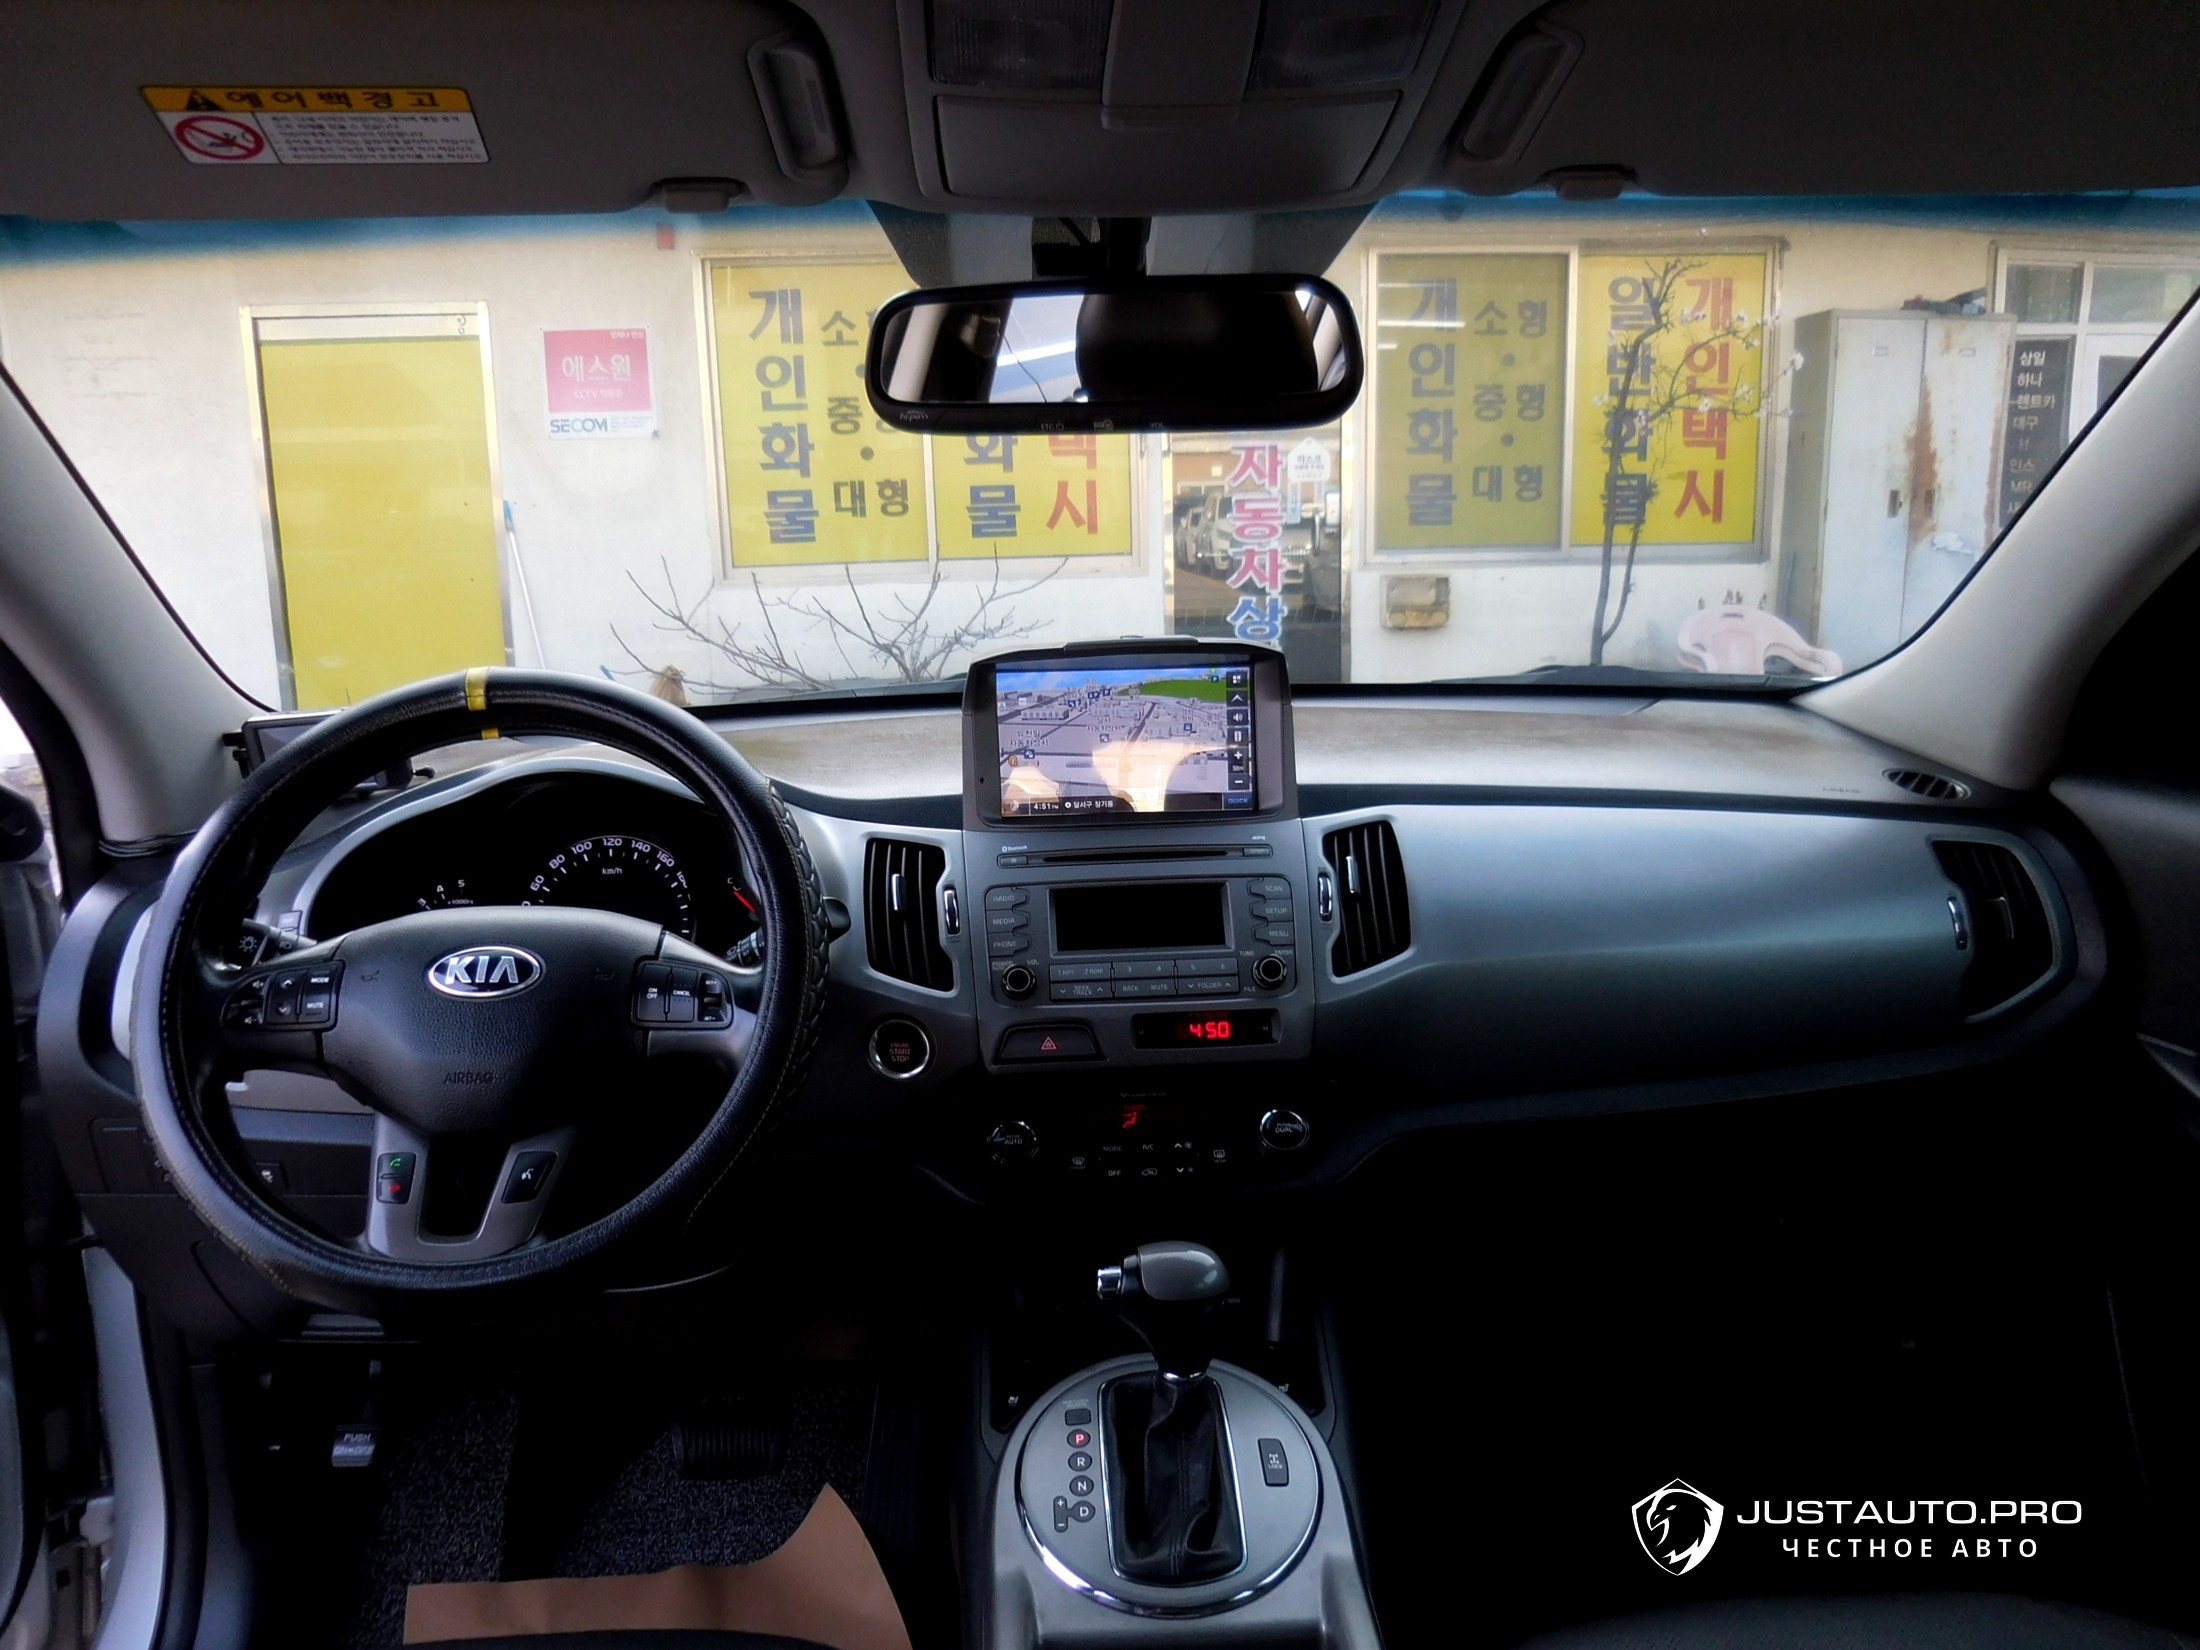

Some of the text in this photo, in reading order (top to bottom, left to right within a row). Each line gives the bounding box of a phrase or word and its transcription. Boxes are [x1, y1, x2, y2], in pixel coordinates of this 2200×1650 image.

[1473, 299, 1548, 339] 소형
[561, 353, 632, 383] 에스원
[748, 287, 820, 544] 개인화물
[1404, 277, 1458, 526] 개인화물
[1472, 383, 1546, 422] 중형
[1674, 276, 1734, 525] 개인택시
[550, 417, 609, 434] SECOM
[832, 478, 910, 518] 대형
[1471, 464, 1543, 503] 대형
[1227, 442, 1287, 642] 자동차상
[444, 955, 519, 985] KIA
[444, 1071, 496, 1085] AIRBAG
